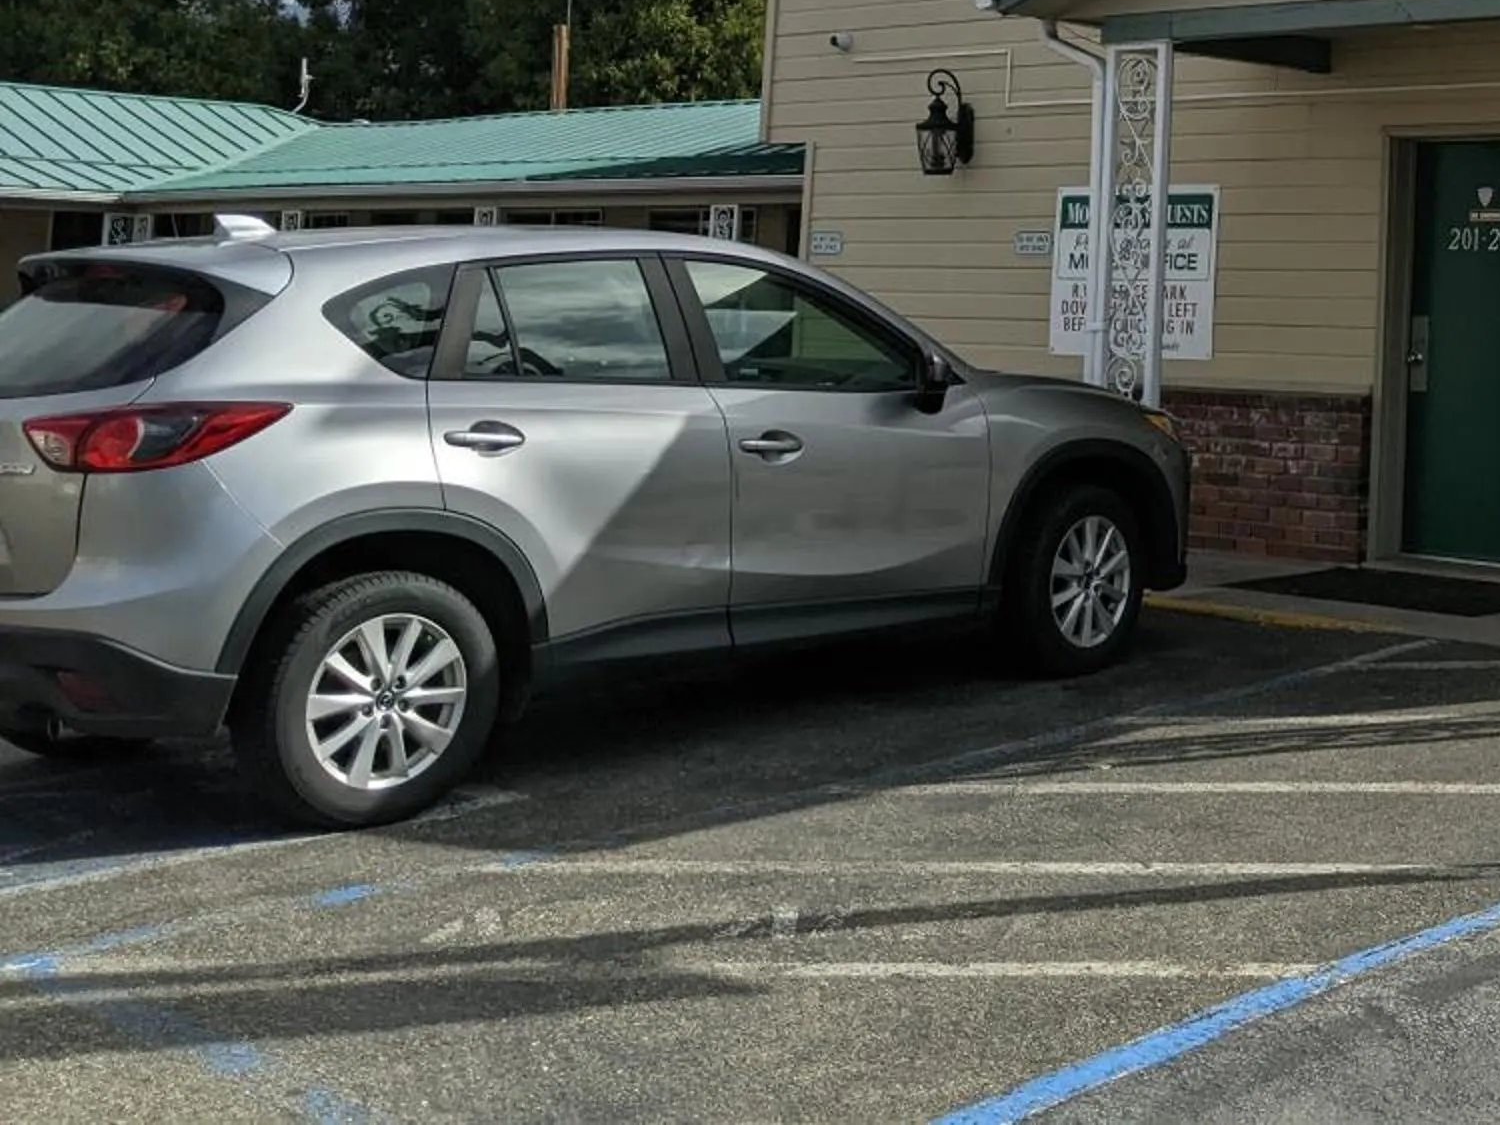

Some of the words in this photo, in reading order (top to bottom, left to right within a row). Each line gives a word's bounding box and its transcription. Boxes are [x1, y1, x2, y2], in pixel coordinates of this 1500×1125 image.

[1167, 203, 1209, 224] UESTS
[1168, 302, 1199, 318] LEFT
[1180, 320, 1195, 336] IN
